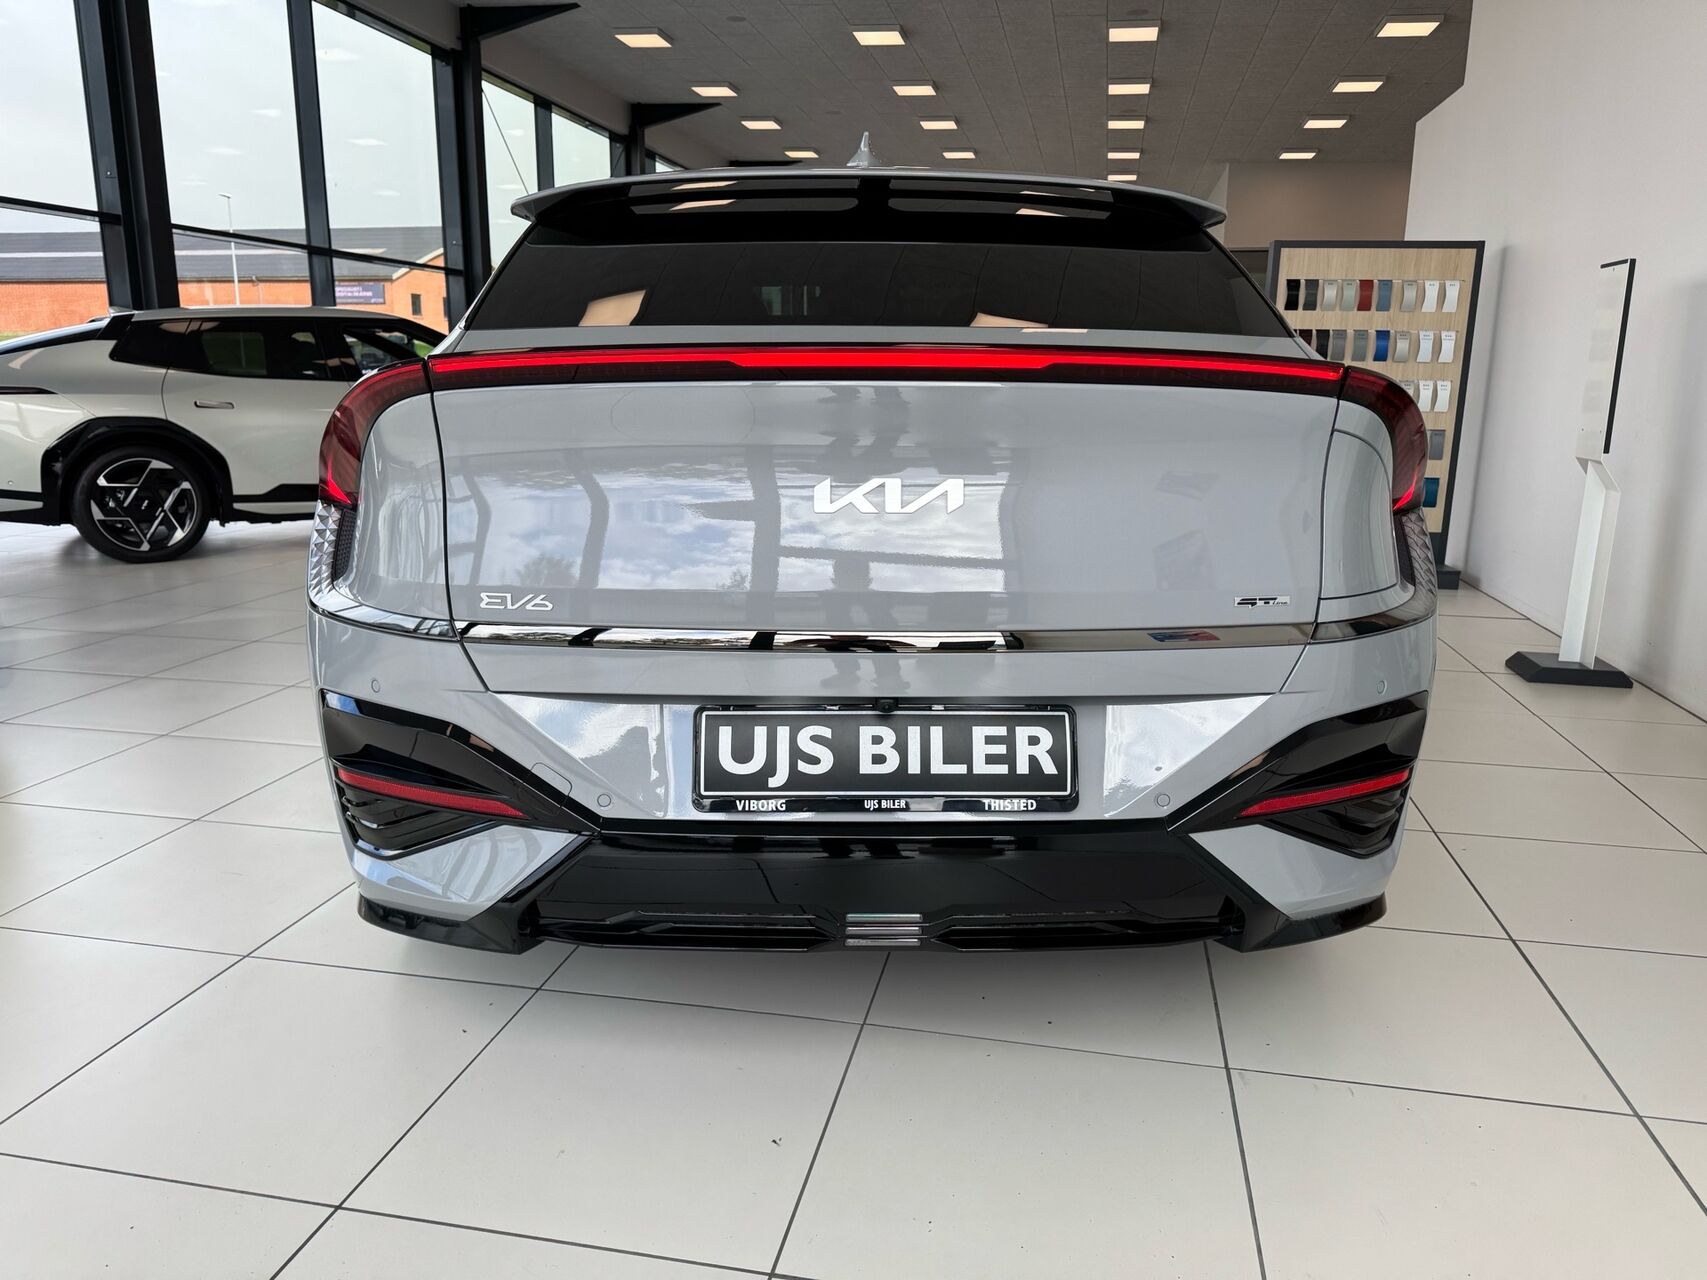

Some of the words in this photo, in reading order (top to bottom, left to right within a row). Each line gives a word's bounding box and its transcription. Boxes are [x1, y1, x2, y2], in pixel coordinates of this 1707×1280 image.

[813, 477, 965, 514] KIA
[479, 592, 554, 611] EV6
[718, 725, 834, 788] UJS
[859, 725, 1058, 775] BILER
[736, 799, 787, 812] VIBORG
[864, 799, 879, 811] UJS
[881, 799, 907, 809] BILER
[983, 799, 1037, 811] THISTED
